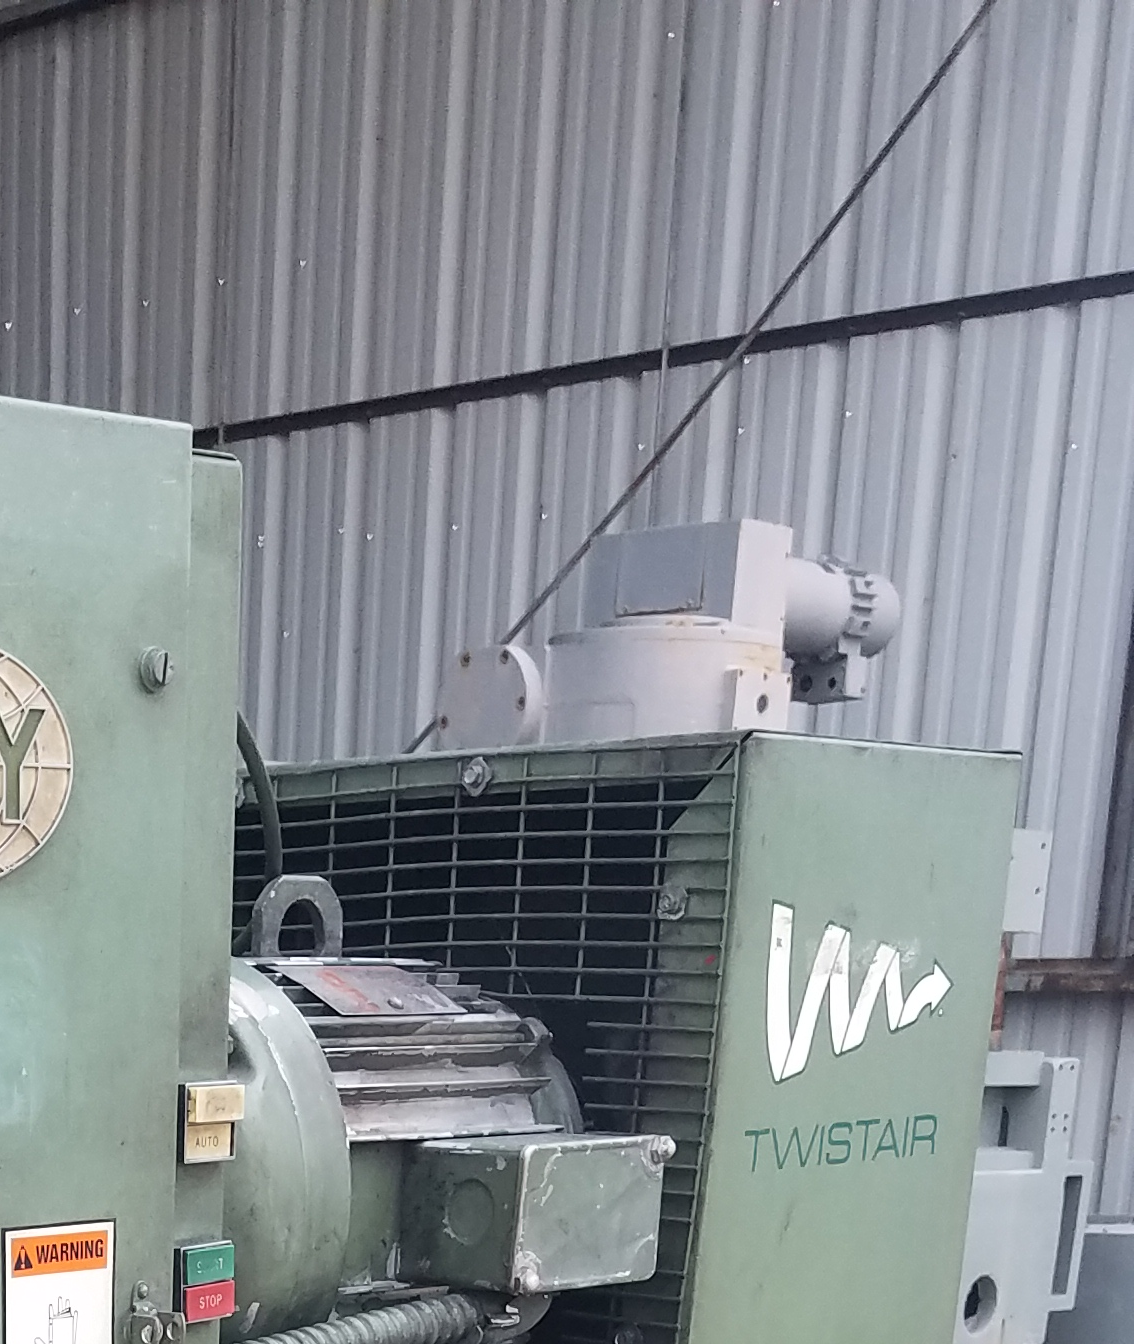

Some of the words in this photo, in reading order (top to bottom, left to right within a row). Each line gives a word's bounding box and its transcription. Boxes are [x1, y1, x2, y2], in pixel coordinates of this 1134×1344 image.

[195, 1136, 219, 1148] AUTO
[744, 1114, 938, 1172] TWISTAIR
[36, 1238, 104, 1264] WARNING
[199, 1294, 223, 1309] STOP
